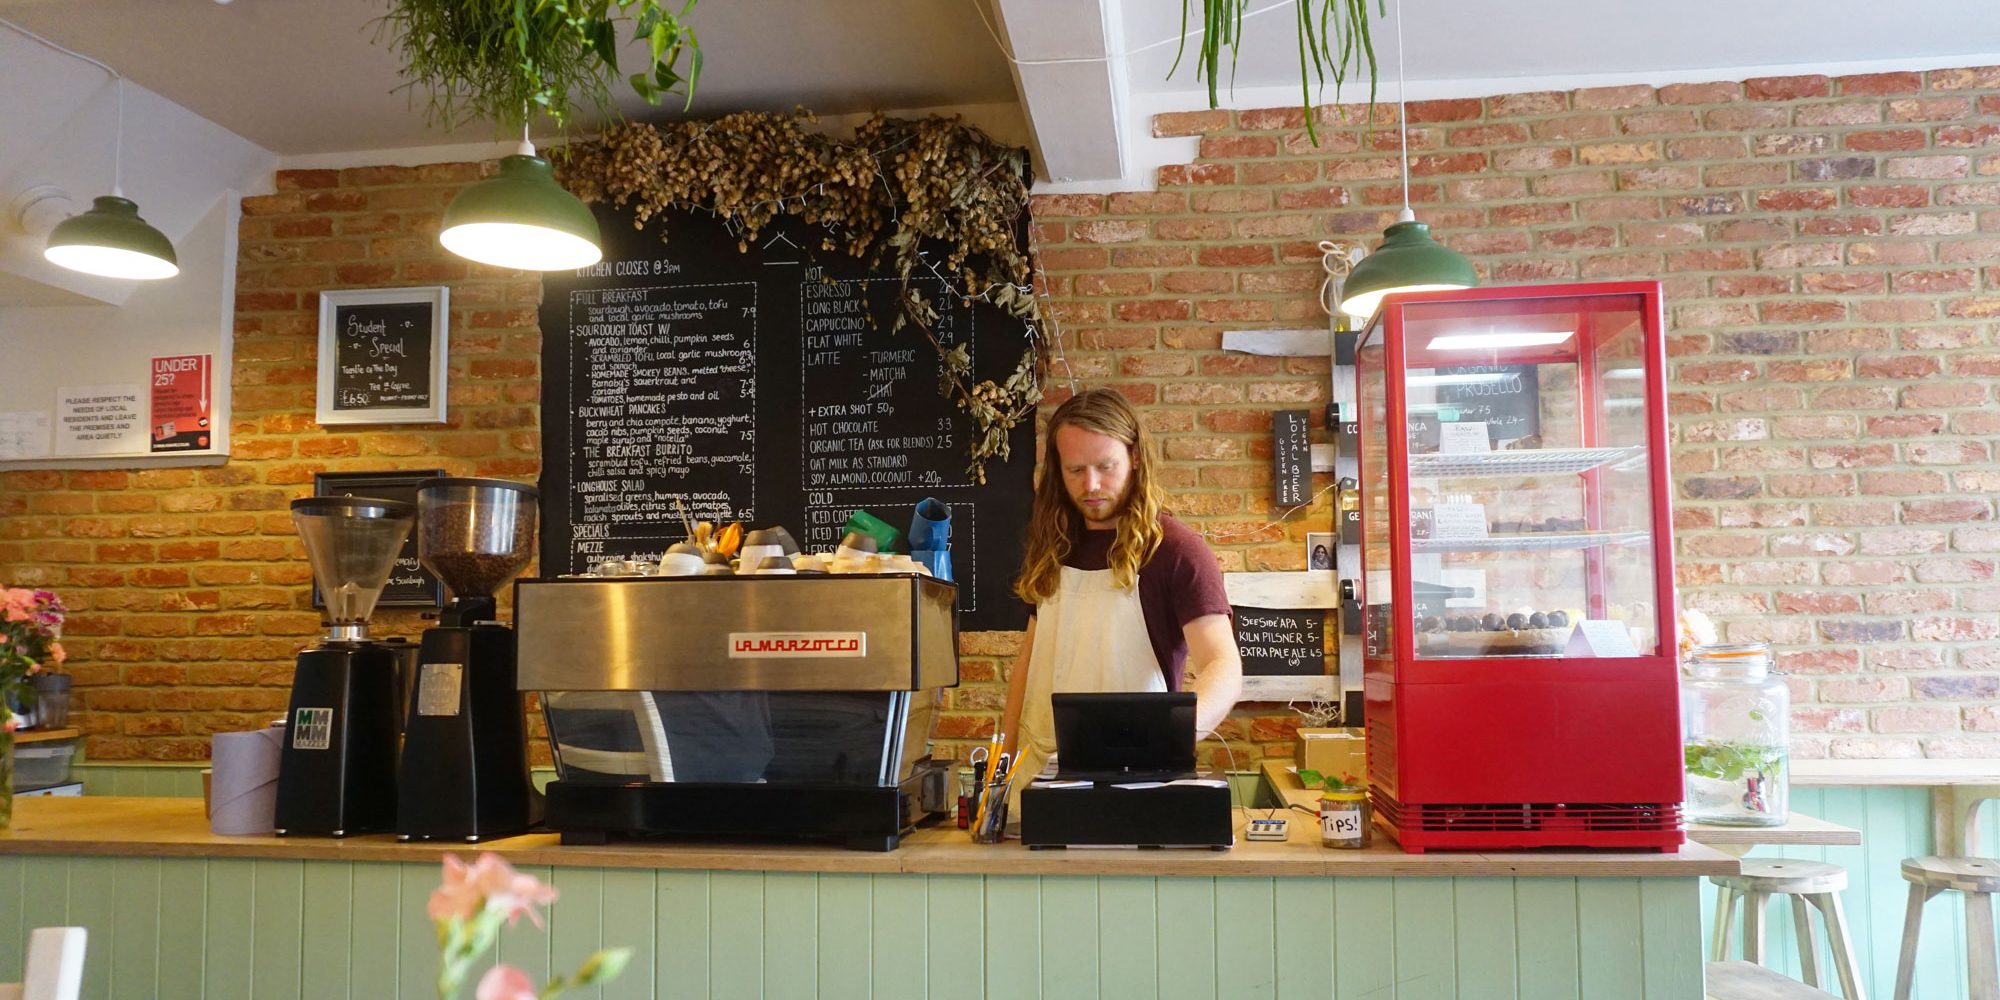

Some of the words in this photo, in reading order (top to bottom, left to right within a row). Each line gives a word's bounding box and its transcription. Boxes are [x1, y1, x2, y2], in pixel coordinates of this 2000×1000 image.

[576, 262, 612, 278] KITCHEN
[616, 260, 648, 276] CLOSES
[805, 266, 823, 281] HOT
[576, 292, 596, 304] FULL
[602, 290, 648, 304] BREAKFAST
[806, 282, 851, 298] ESPRESSO
[674, 300, 707, 312] tomato,
[709, 299, 728, 310] tofu
[808, 302, 830, 314] LONG
[834, 300, 860, 313] BLACK
[632, 312, 654, 324] garlic
[659, 311, 703, 320] mushrooms
[806, 317, 864, 332] CAPPUCCINO
[348, 314, 386, 336] Student
[576, 324, 626, 336] SOURDOUGH
[628, 324, 653, 336] TOAST
[658, 323, 670, 335] W/
[369, 336, 407, 358] Special
[674, 334, 708, 347] pumpkin
[712, 333, 734, 341] seeds
[744, 340, 750, 348] 6
[808, 336, 831, 348] FLAT
[834, 333, 862, 347] WHITE
[590, 354, 632, 362] SCRAMBLED
[656, 350, 676, 360] local
[678, 349, 700, 362] garlic
[704, 348, 752, 358] mushrooms
[610, 345, 648, 354] coriander
[808, 351, 840, 366] LATTE
[870, 350, 916, 364] TURMERIC
[156, 359, 198, 372] UNDER
[385, 364, 398, 378] Day
[592, 362, 606, 370] and
[610, 362, 638, 371] spinach
[592, 370, 628, 378] HOMEMADE
[633, 368, 660, 378] SMOKEY
[692, 366, 718, 374] melted
[155, 374, 176, 386] 25?
[870, 366, 906, 381] MATCHA
[592, 378, 630, 388] Barnaby's
[634, 376, 679, 386] sauerkraut
[680, 376, 696, 384] and
[592, 387, 628, 396] coriander
[626, 392, 666, 402] homemade
[668, 391, 688, 404] pesto
[690, 390, 704, 400] and
[579, 406, 624, 418] BUCKWHEAT
[629, 404, 666, 414] PANCAKES
[850, 404, 872, 414] SHOT
[876, 402, 894, 416] 50p
[586, 419, 608, 428] berry
[609, 418, 624, 426] and
[626, 417, 644, 426] chia
[682, 415, 716, 425] banana,
[717, 414, 752, 426] yoghurt,
[586, 428, 608, 436] cacao
[610, 427, 629, 436] nibs,
[630, 426, 664, 436] pumpkin
[667, 426, 692, 435] seeds,
[694, 425, 728, 434] coconut,
[810, 423, 828, 436] HOT
[832, 421, 878, 434] CHOCOLATE
[586, 437, 608, 446] maple
[612, 436, 635, 446] syrup
[636, 434, 652, 442] and
[1289, 414, 1299, 460] LOCAL
[582, 446, 600, 458] THE
[606, 444, 650, 458] BREAKFAST
[656, 444, 692, 456] BURRITO
[810, 440, 846, 453] ORGANIC
[849, 438, 864, 450] TEA
[868, 438, 884, 450] (ASK
[887, 438, 900, 448] FOR
[903, 436, 934, 448] BLENDS)
[588, 458, 628, 468] scrambled
[654, 456, 682, 466] refried
[686, 456, 710, 464] beans,
[710, 452, 752, 468] guacamole,
[810, 458, 824, 470] OAT
[828, 457, 848, 469] MILK
[852, 457, 864, 469] AS
[867, 455, 908, 468] STANDARD
[1279, 438, 1288, 474] GLUTEN
[606, 468, 626, 476] salsa
[628, 466, 644, 474] and
[646, 466, 666, 478] spicy
[668, 466, 690, 478] mayo
[810, 474, 828, 486] SOY,
[872, 471, 912, 483] COCONUT
[578, 480, 618, 492] LONGHOUSE
[622, 480, 645, 491] SALAD
[1291, 466, 1302, 502] BEER
[584, 492, 623, 504] spiralised
[626, 493, 654, 503] greens,
[692, 490, 730, 500] avocado,
[809, 492, 832, 504] COLD
[616, 502, 640, 512] olives,
[641, 502, 666, 510] citrus
[692, 501, 732, 510] tomatoes,
[612, 512, 644, 522] sprouts
[646, 512, 660, 520] and
[812, 510, 830, 524] ICED
[573, 524, 610, 538] SPECIALS
[812, 527, 832, 540] ICED
[578, 542, 604, 554] MEZZE
[1280, 618, 1298, 629] APA
[1240, 632, 1260, 642] KILN
[1262, 632, 1304, 644] PILSNER
[735, 640, 752, 652] LA
[1240, 646, 1268, 658] EXTRA
[1270, 648, 1289, 658] PALE
[1292, 648, 1307, 658] ALE
[1322, 816, 1358, 832] Tips!
